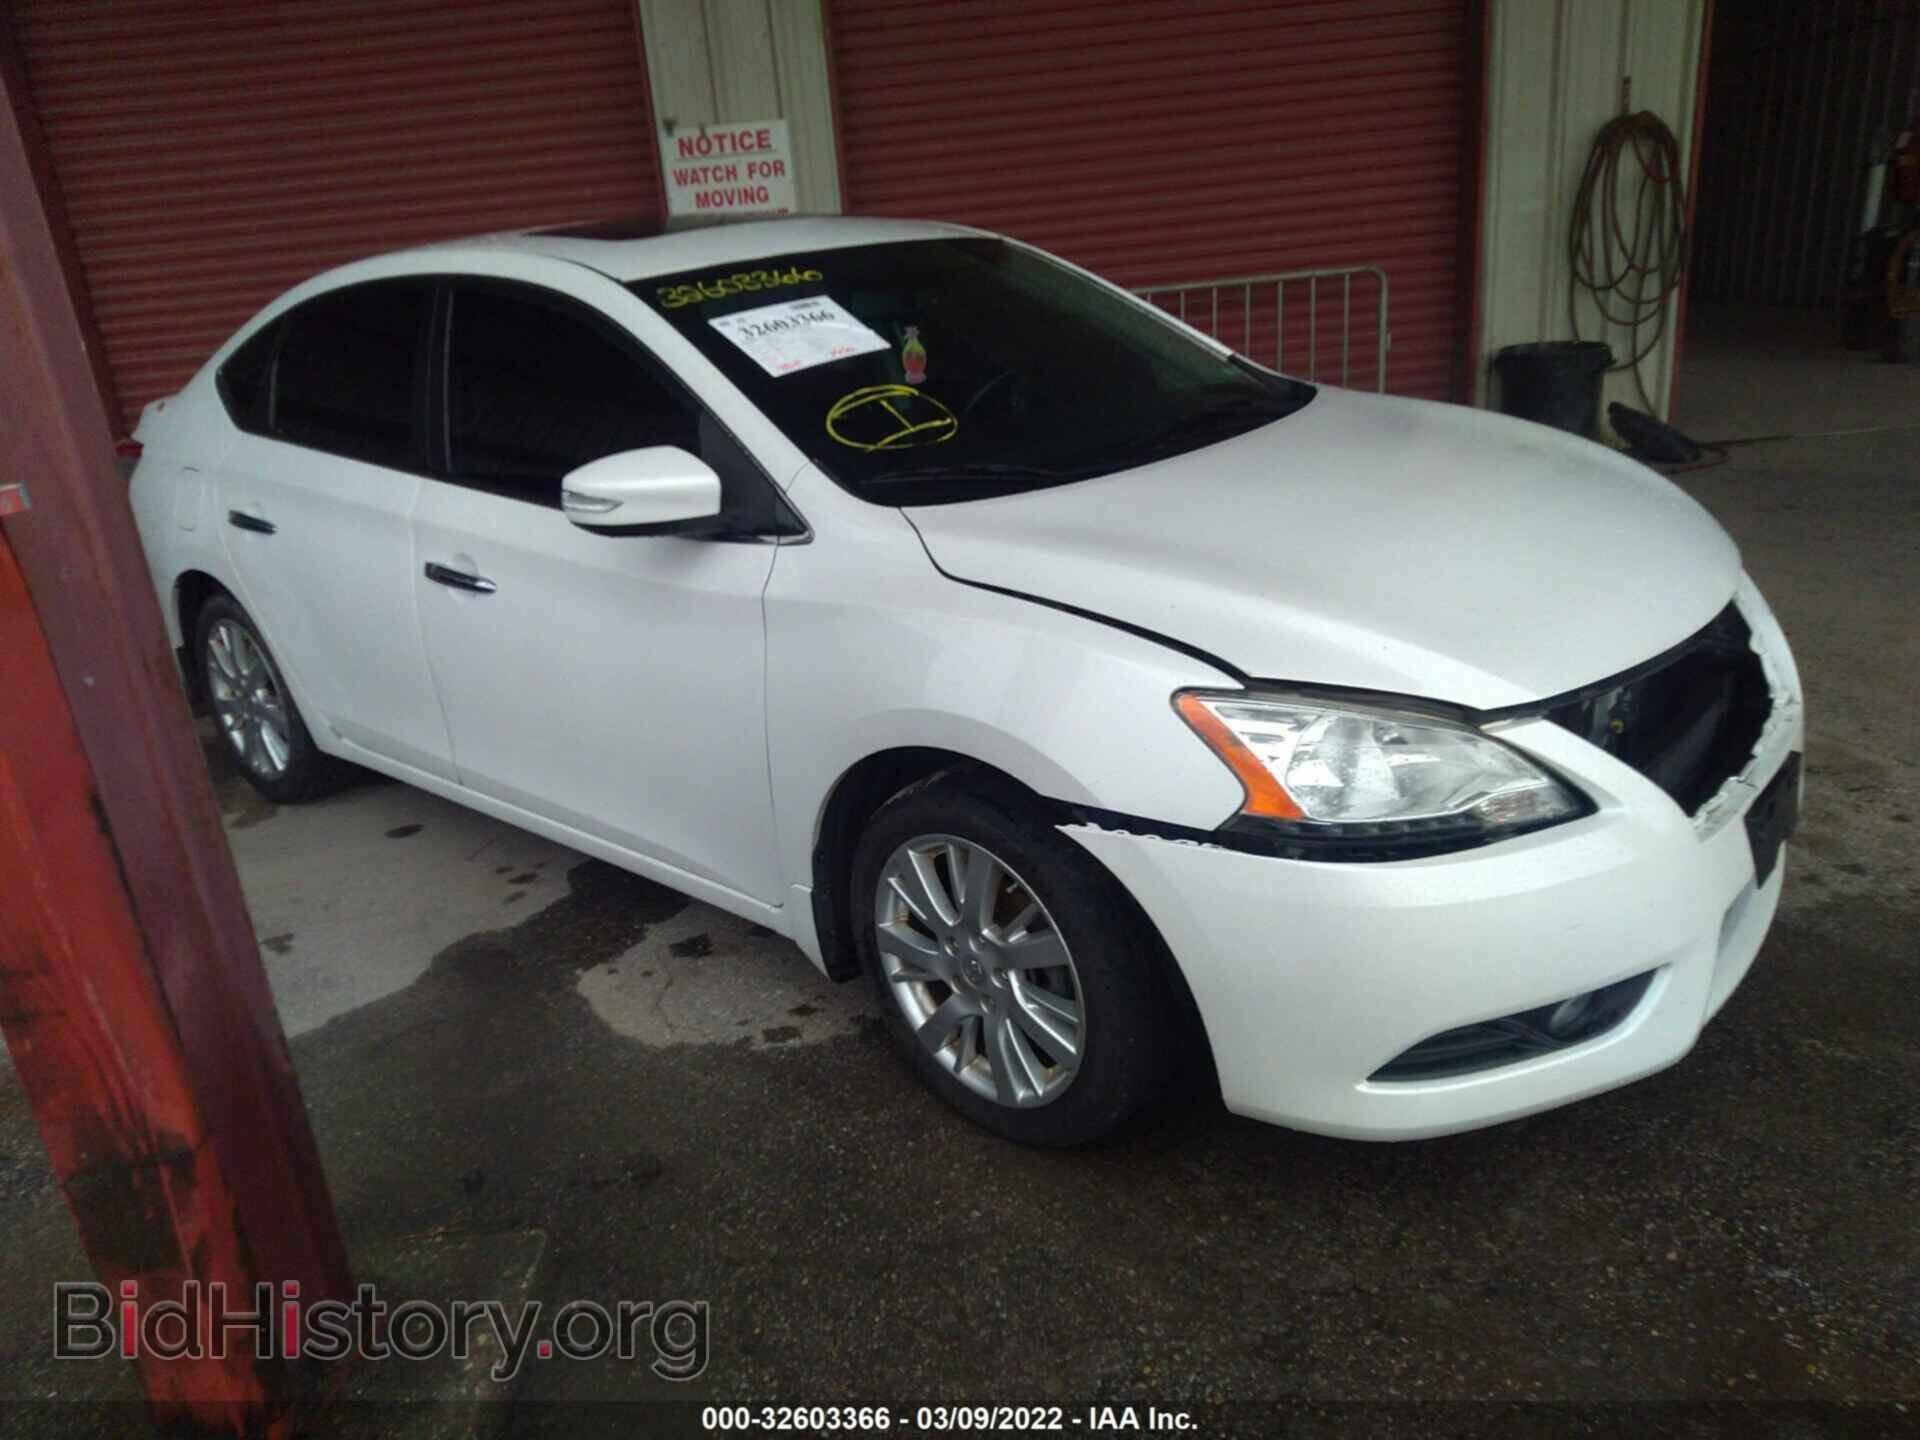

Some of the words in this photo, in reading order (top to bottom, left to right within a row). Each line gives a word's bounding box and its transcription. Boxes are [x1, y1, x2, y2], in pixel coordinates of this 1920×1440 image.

[677, 129, 772, 157] NOTICE
[673, 165, 737, 186] WATCH
[747, 160, 785, 179] FOR
[695, 186, 769, 208] MOVING
